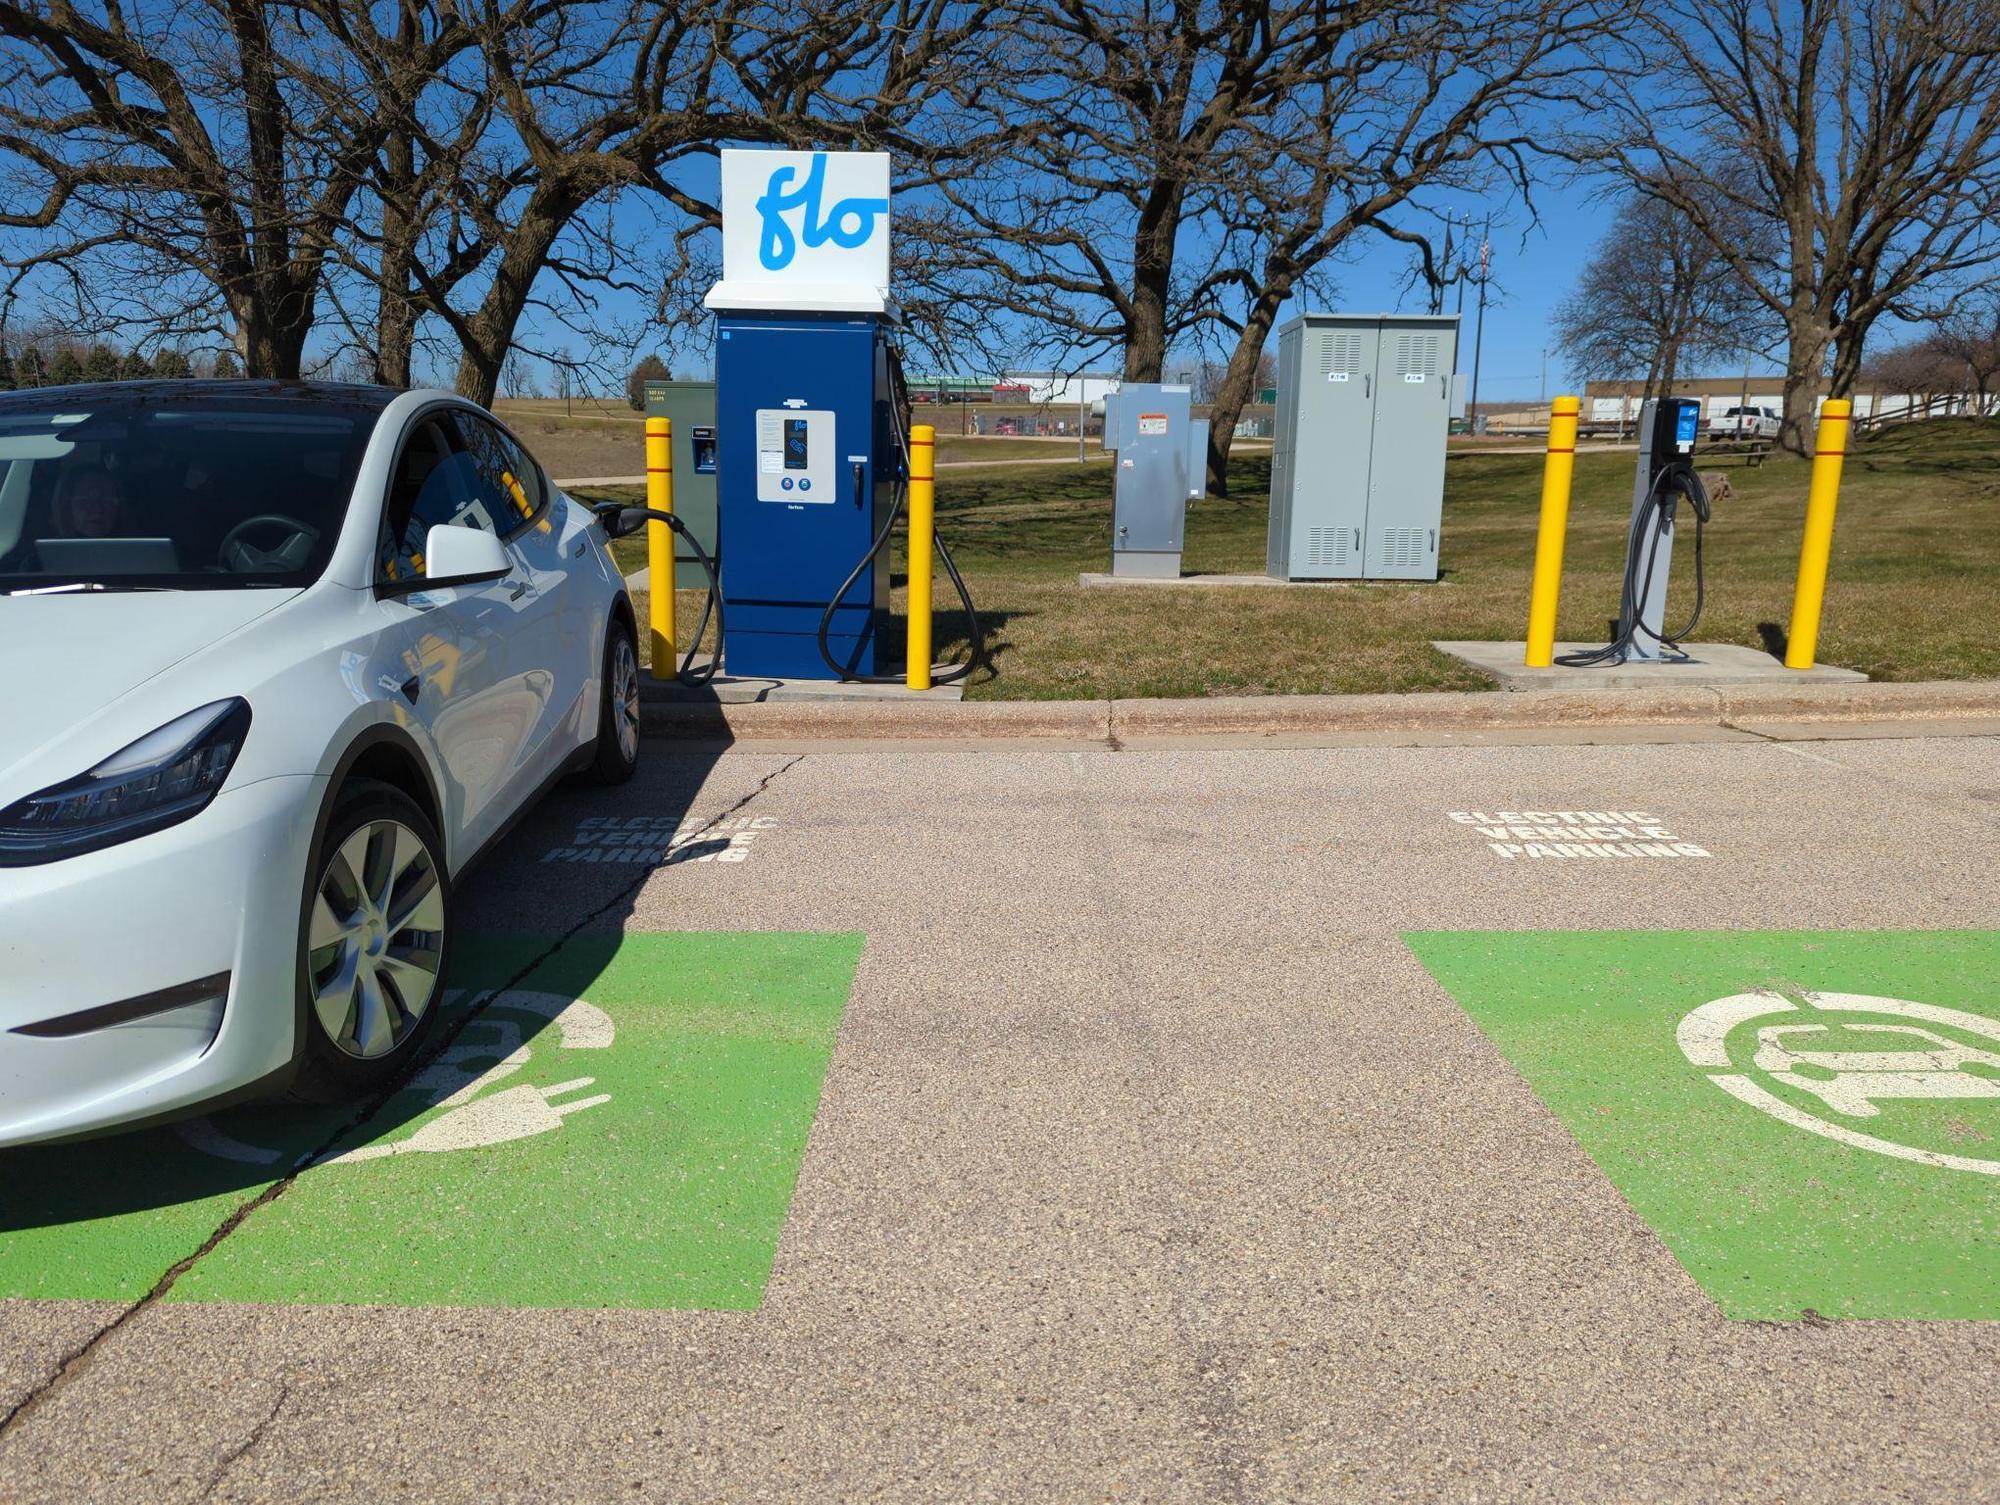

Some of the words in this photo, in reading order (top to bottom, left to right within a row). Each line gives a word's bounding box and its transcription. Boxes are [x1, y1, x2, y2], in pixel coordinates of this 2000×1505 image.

[755, 153, 888, 271] flo
[1448, 811, 1661, 824] ELECTRIC
[1474, 826, 1679, 840] VEHICLE
[1486, 843, 1712, 858] PARKING
